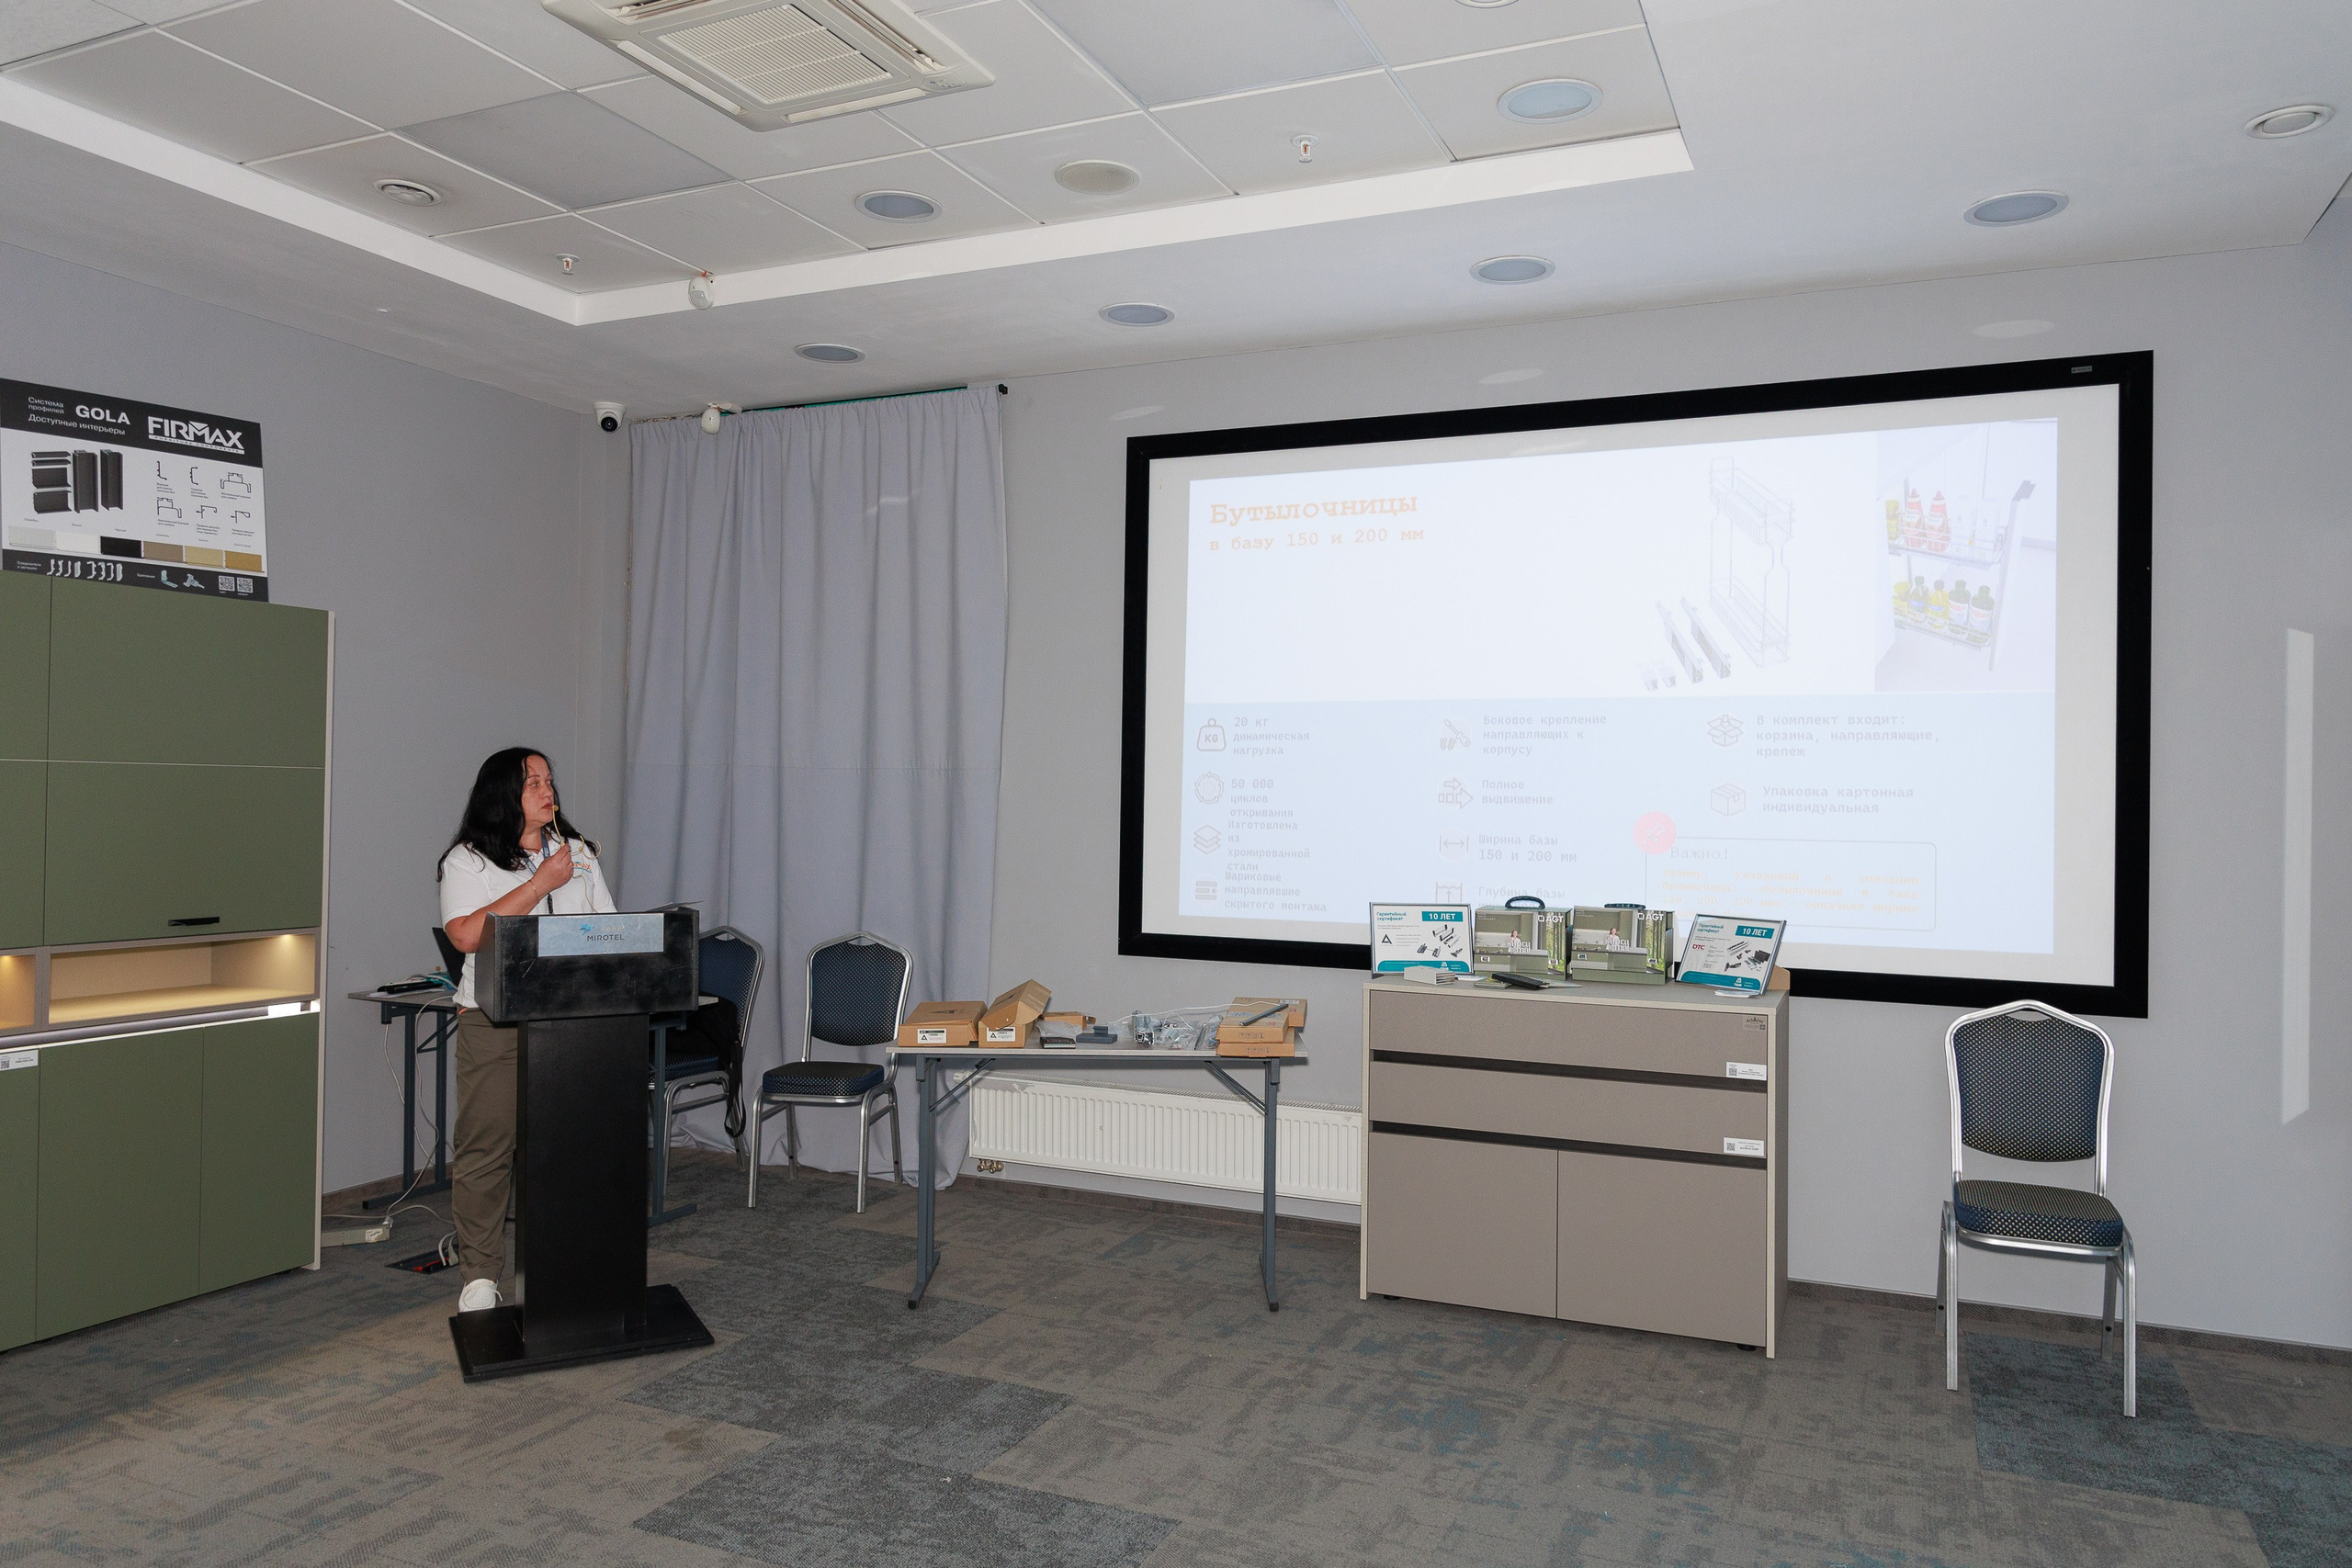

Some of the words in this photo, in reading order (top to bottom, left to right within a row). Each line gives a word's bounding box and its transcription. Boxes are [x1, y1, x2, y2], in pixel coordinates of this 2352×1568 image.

[28, 397, 64, 408] Система
[28, 404, 64, 414] профилей
[75, 405, 130, 424] GOLA
[28, 413, 78, 428] Доступные
[79, 423, 126, 435] интерьеры
[148, 416, 244, 449] FIRMAX
[1209, 496, 1418, 526] Бутылочницы
[1209, 540, 1220, 551] в
[1231, 536, 1275, 551] базу
[1287, 532, 1318, 547] 150
[1330, 533, 1342, 545] и
[1354, 528, 1388, 543] 200
[1400, 529, 1425, 541] мм
[1235, 716, 1248, 727] 20
[1255, 718, 1270, 727] кг
[1484, 716, 1533, 726] Боковое
[1541, 716, 1607, 727] крепление
[1756, 715, 1764, 725] В
[1773, 716, 1838, 726] комплект
[1848, 716, 1905, 727] входит:
[1204, 733, 1218, 743] KG
[1233, 732, 1310, 741] динамическая
[1483, 731, 1569, 740] направляющих
[1577, 731, 1584, 739] к
[1756, 731, 1820, 743] корзина,
[1830, 731, 1940, 743] направляющие,
[1233, 747, 1284, 757] нагрузка
[1483, 746, 1532, 757] корпусу
[1756, 747, 1806, 759] крепеж
[1231, 779, 1245, 789] 50
[1252, 779, 1274, 789] 000
[1482, 779, 1525, 789] Полное
[1763, 785, 1828, 797] Упаковка
[1838, 788, 1914, 799] картонная
[1230, 795, 1268, 804] циклов
[1482, 795, 1554, 805] выдвижение
[1230, 809, 1294, 818] открывания
[1763, 803, 1879, 815] индивидуальная
[1227, 820, 1298, 830] Изготовлена
[1227, 835, 1240, 843] из
[1478, 834, 1521, 845] Ширина
[1529, 835, 1558, 845] базы
[1227, 847, 1310, 859] хромированной
[1478, 849, 1503, 861] 150
[1510, 852, 1519, 861] и
[1527, 851, 1552, 862] 200
[1560, 852, 1577, 862] мм
[1670, 847, 1729, 860] Важно!
[1227, 863, 1259, 872] стали
[1225, 872, 1282, 883] Шариковые
[1478, 886, 1528, 897] Глубина
[1536, 888, 1566, 898] базы
[1225, 900, 1274, 911] скрытого
[1282, 902, 1327, 912] монтажа
[1545, 915, 1564, 923] AGT
[1645, 913, 1664, 921] AGT
[586, 933, 624, 942] MIROTEL
[1751, 929, 1768, 937] ЛЕТ
